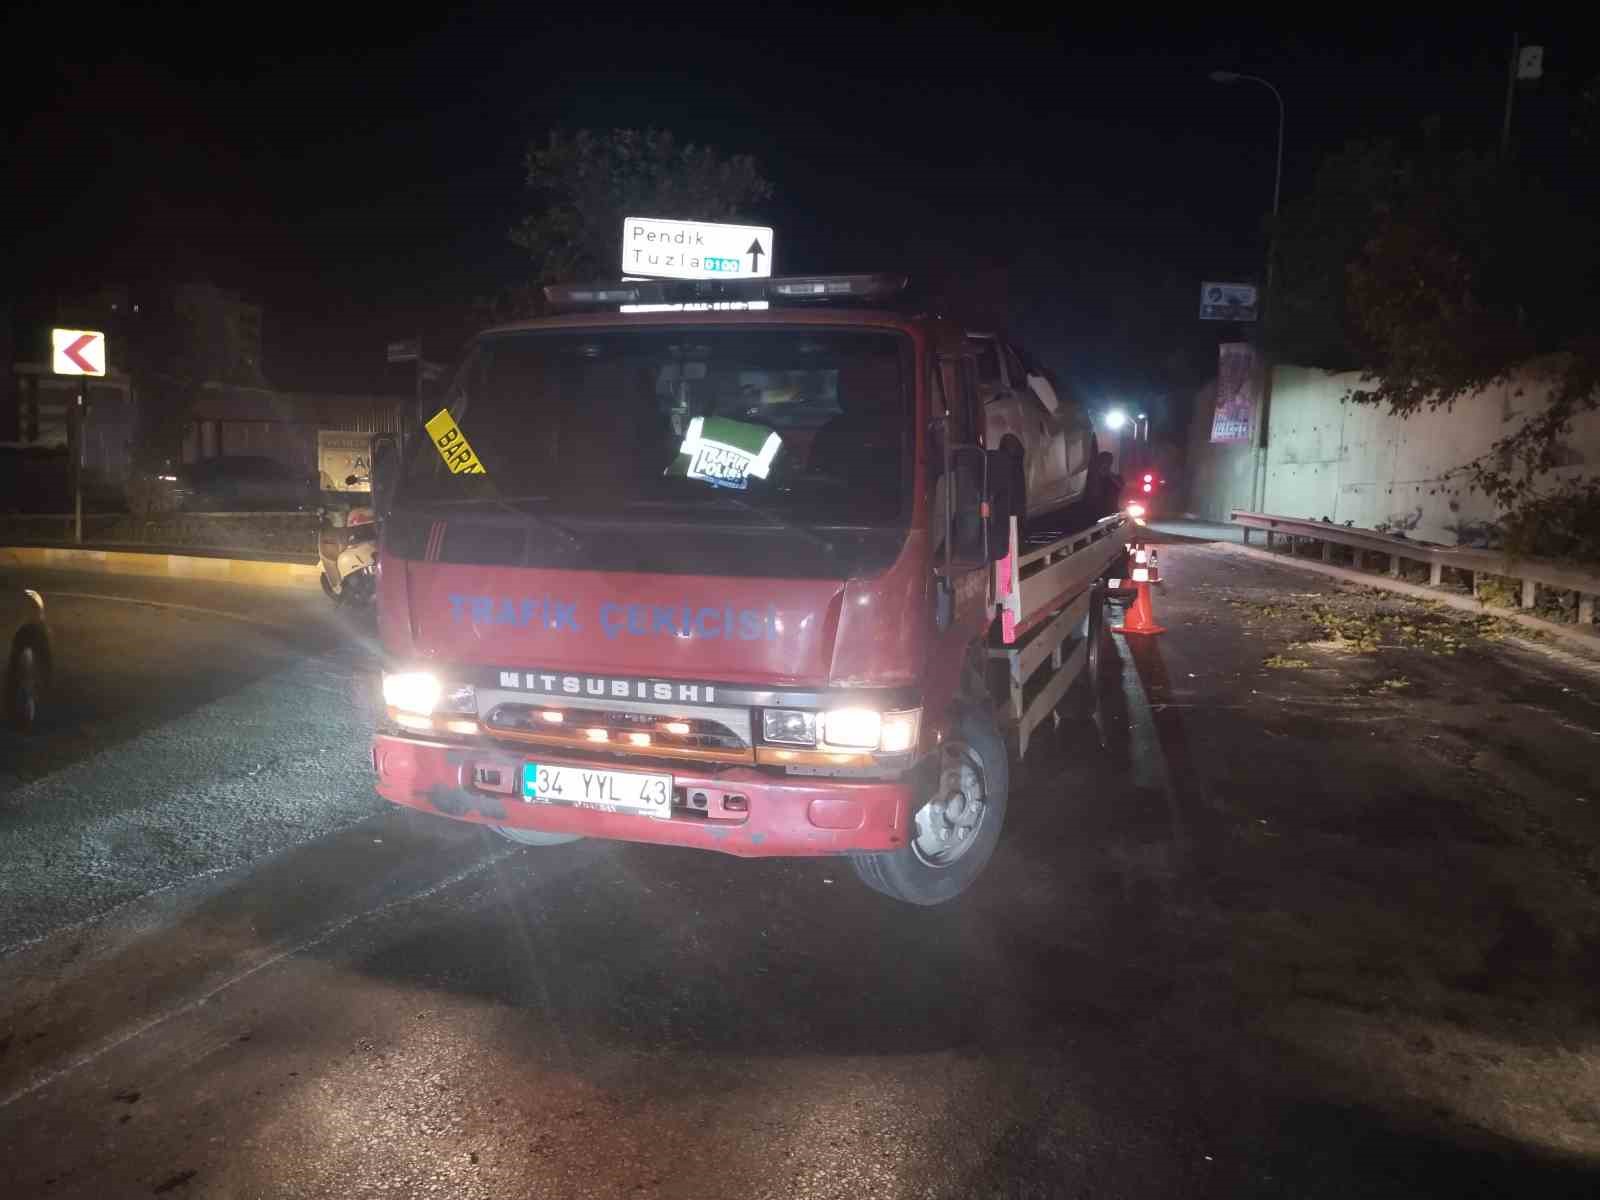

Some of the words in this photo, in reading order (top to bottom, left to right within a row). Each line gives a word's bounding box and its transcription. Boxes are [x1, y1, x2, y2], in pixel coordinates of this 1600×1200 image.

[633, 226, 705, 246] Pendik
[632, 249, 700, 269] Tuzla
[499, 671, 716, 703] MITSUBISHI
[538, 768, 563, 796] 34
[581, 772, 622, 802] YYL
[639, 779, 667, 806] 43
